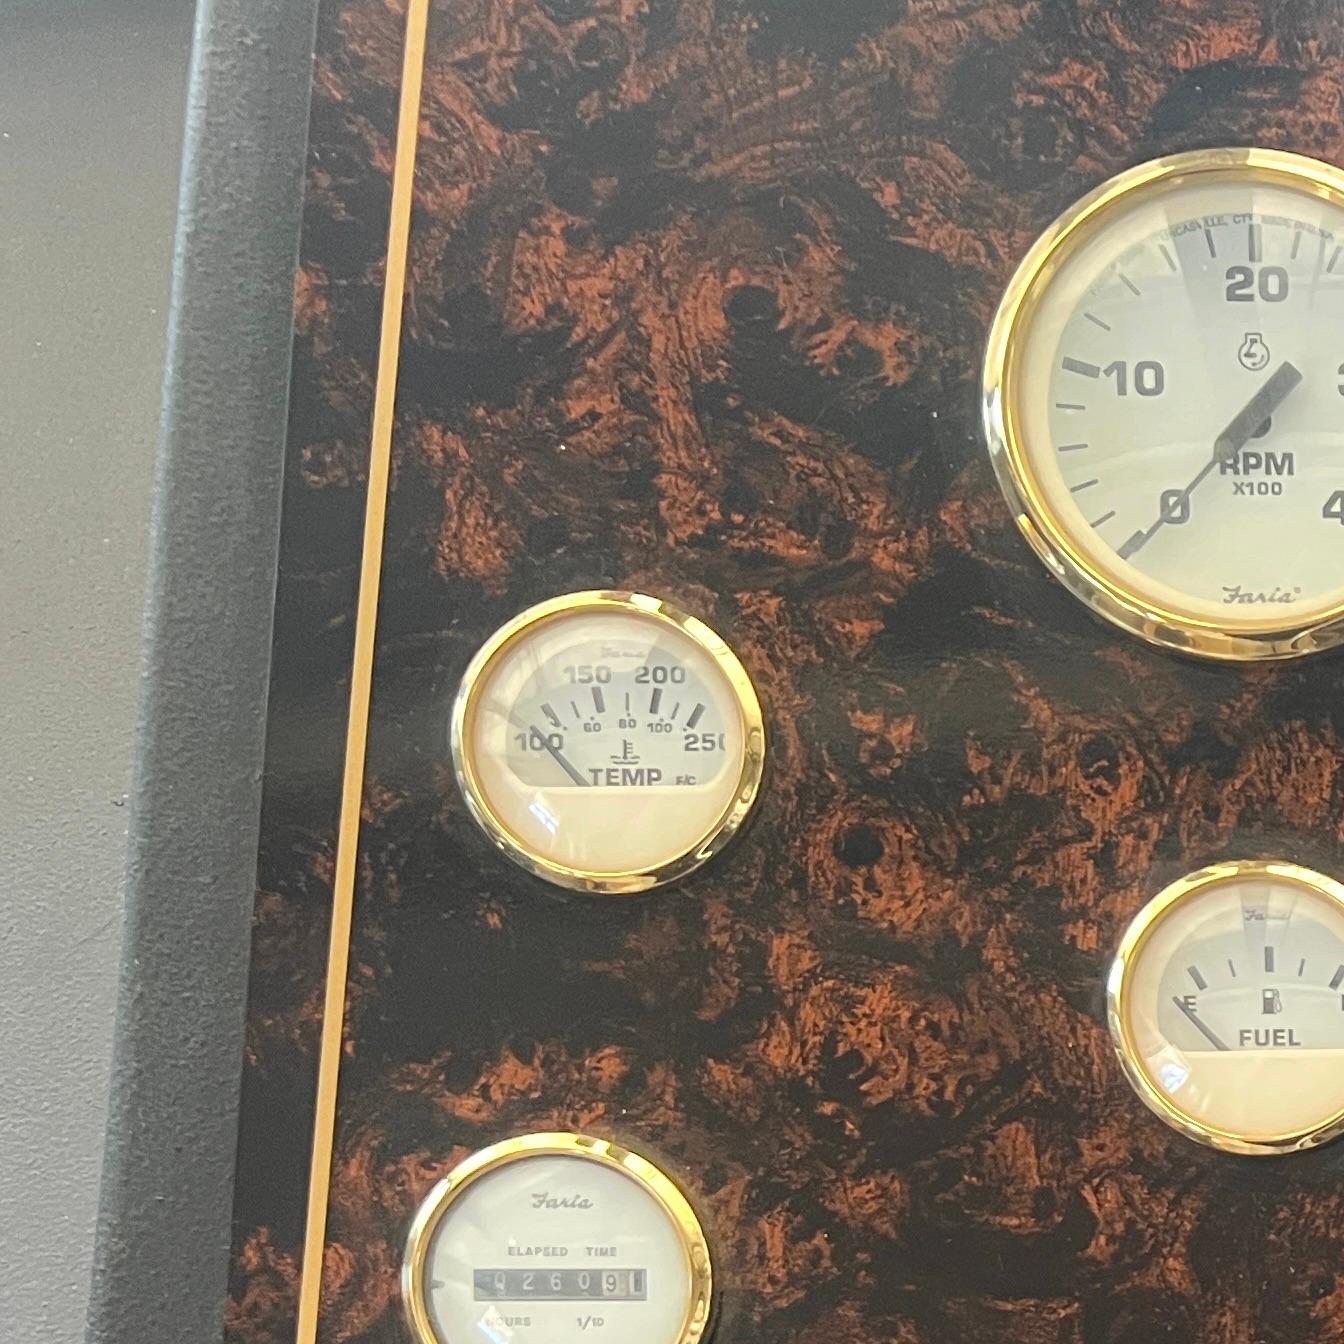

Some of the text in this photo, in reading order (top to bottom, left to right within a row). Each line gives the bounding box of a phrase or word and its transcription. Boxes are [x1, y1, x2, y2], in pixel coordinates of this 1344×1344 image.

[1225, 266, 1289, 302] 20
[1104, 360, 1165, 397] 10
[1219, 452, 1295, 476] RPM
[1232, 481, 1283, 496] X100
[1160, 489, 1191, 524] 0
[565, 665, 612, 684] 150
[634, 666, 686, 684] 200
[647, 722, 672, 733] 100
[514, 733, 564, 751] 100
[588, 768, 662, 787] TEMP
[1183, 995, 1198, 1013] E
[1239, 1029, 1302, 1047] FUEL
[531, 1192, 594, 1209] Faria
[507, 1246, 617, 1257] ELAPSED TIME
